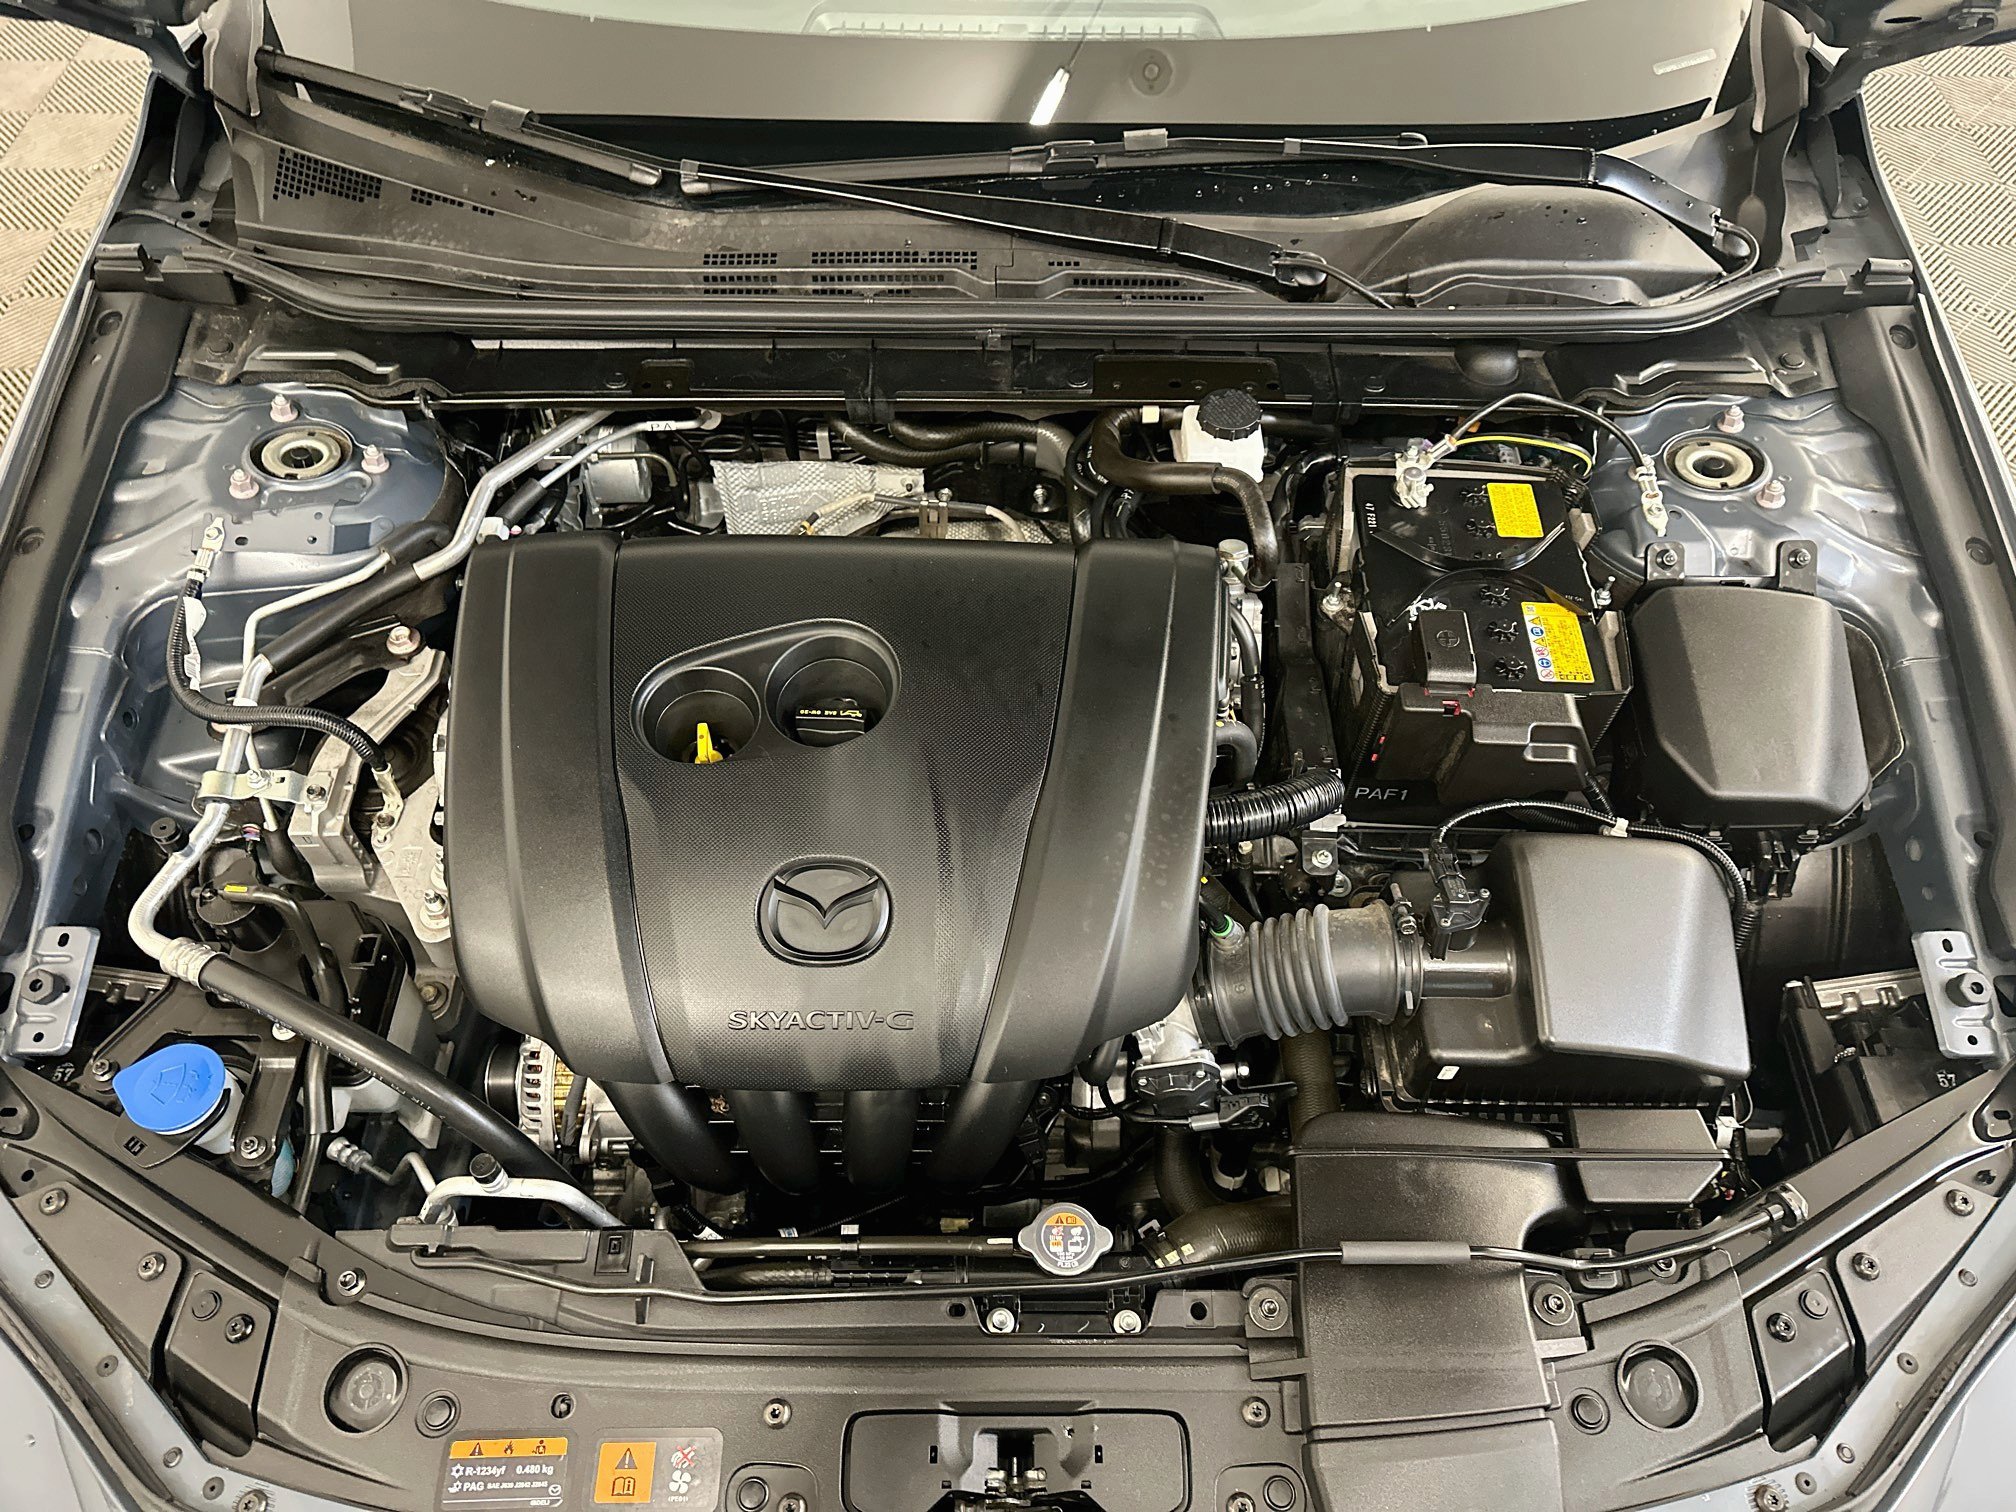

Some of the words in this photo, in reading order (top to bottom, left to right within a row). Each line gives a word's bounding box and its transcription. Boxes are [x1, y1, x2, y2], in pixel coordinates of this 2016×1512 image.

[1354, 787, 1409, 801] PAF1
[727, 1010, 915, 1031] SKYACTIV-G
[51, 1067, 76, 1083] 57
[1936, 1073, 1957, 1088] 57
[464, 1465, 507, 1478] R-1234yf
[515, 1464, 541, 1476] 0.480
[541, 1464, 554, 1476] kg
[462, 1481, 486, 1492] PAG
[486, 1481, 500, 1490] SAE
